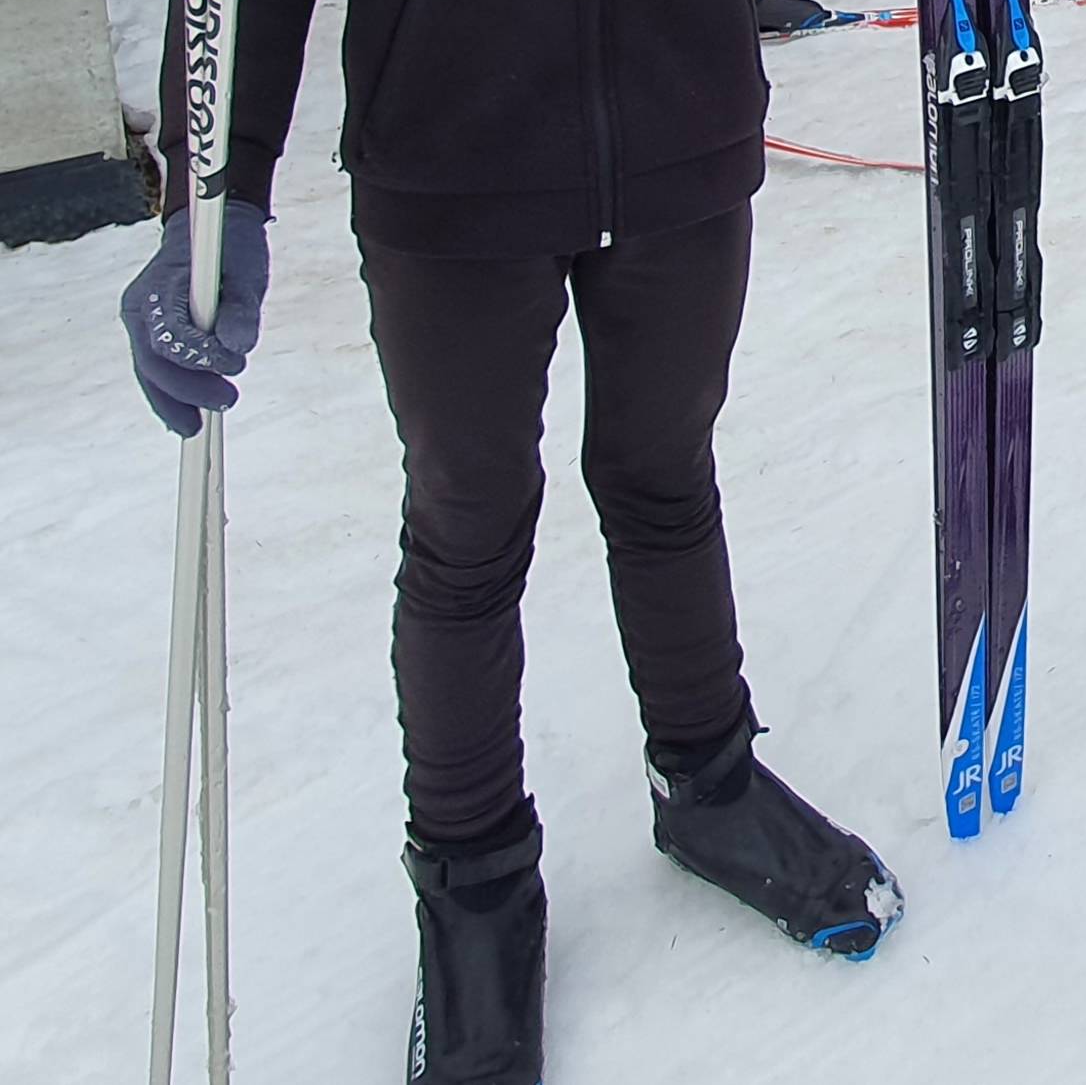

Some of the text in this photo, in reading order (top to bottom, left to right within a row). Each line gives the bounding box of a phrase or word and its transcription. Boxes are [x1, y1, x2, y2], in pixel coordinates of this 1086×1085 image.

[964, 227, 975, 297] PROLINK
[151, 307, 213, 367] KIPSTA
[953, 764, 982, 795] JR
[995, 744, 1023, 776] JR
